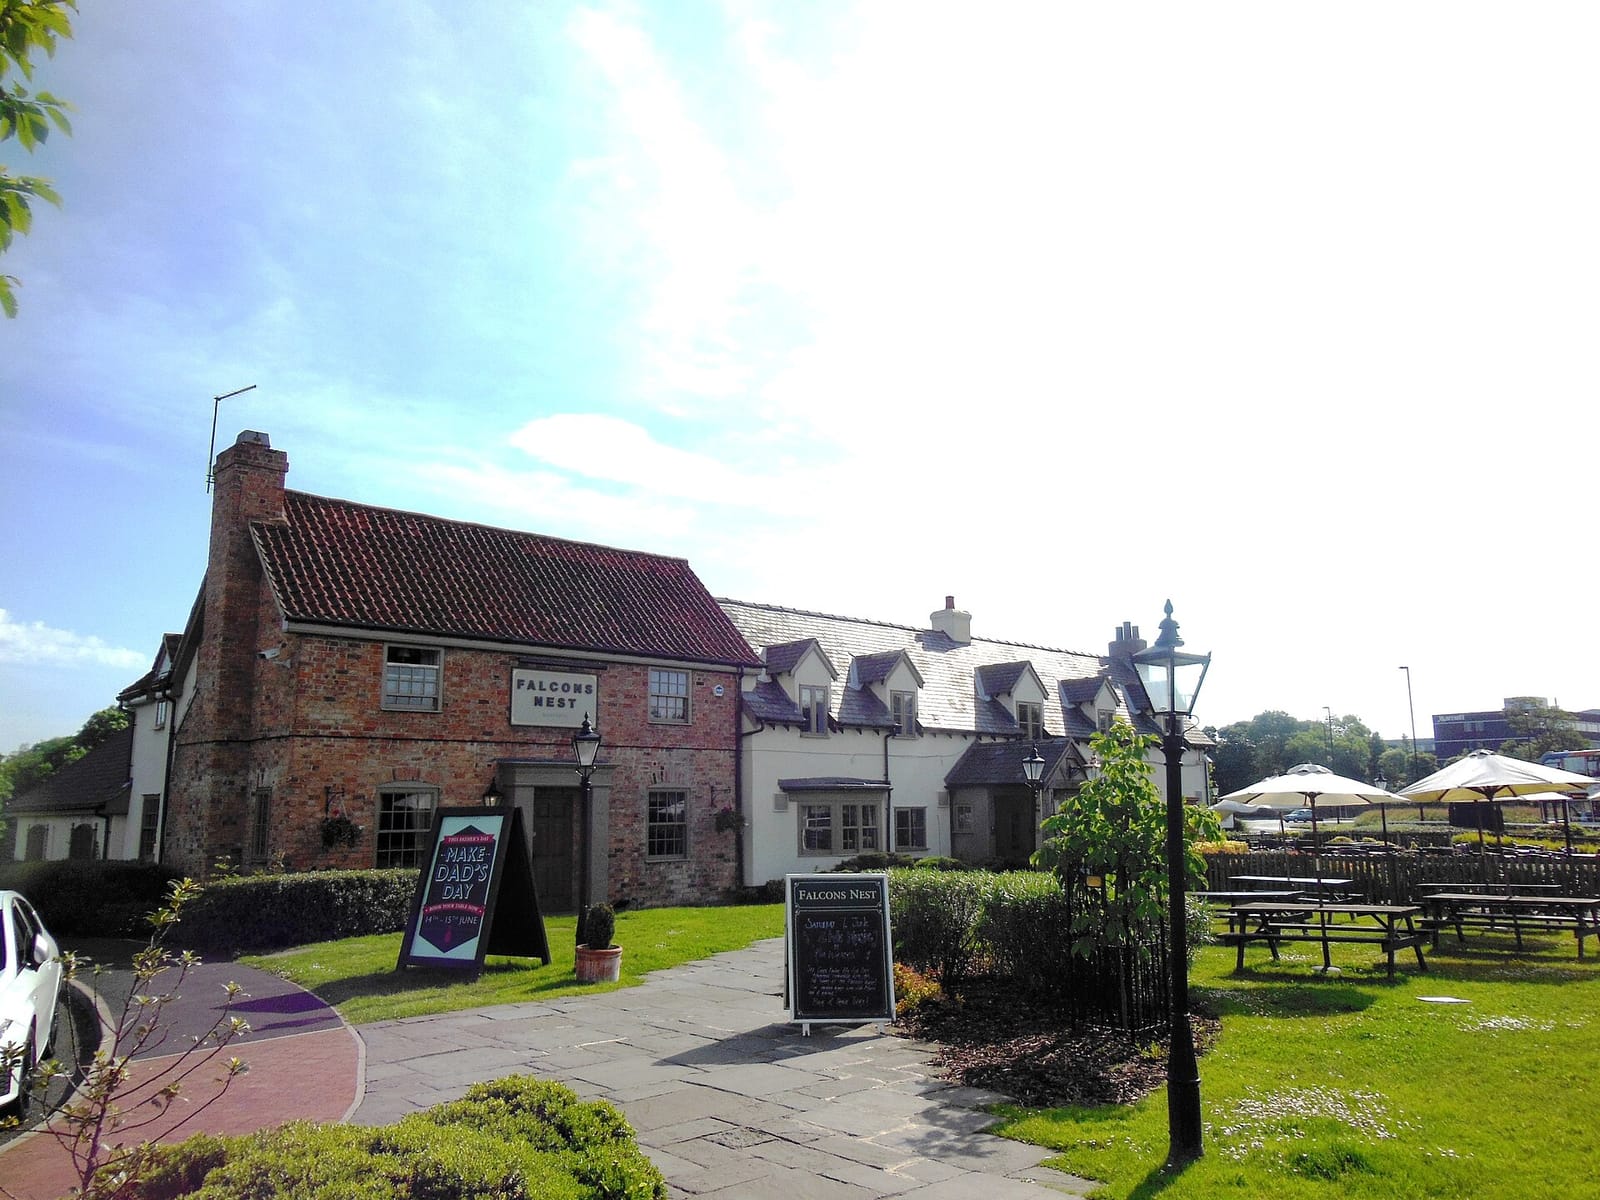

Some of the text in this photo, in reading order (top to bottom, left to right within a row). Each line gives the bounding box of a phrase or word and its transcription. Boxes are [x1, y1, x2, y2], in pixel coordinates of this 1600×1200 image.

[517, 679, 593, 695] FALCONS
[534, 696, 577, 708] NEST
[446, 846, 486, 862] MAKE
[435, 864, 489, 882] DAD'S
[442, 884, 474, 900] DAY
[459, 916, 479, 925] JUNE
